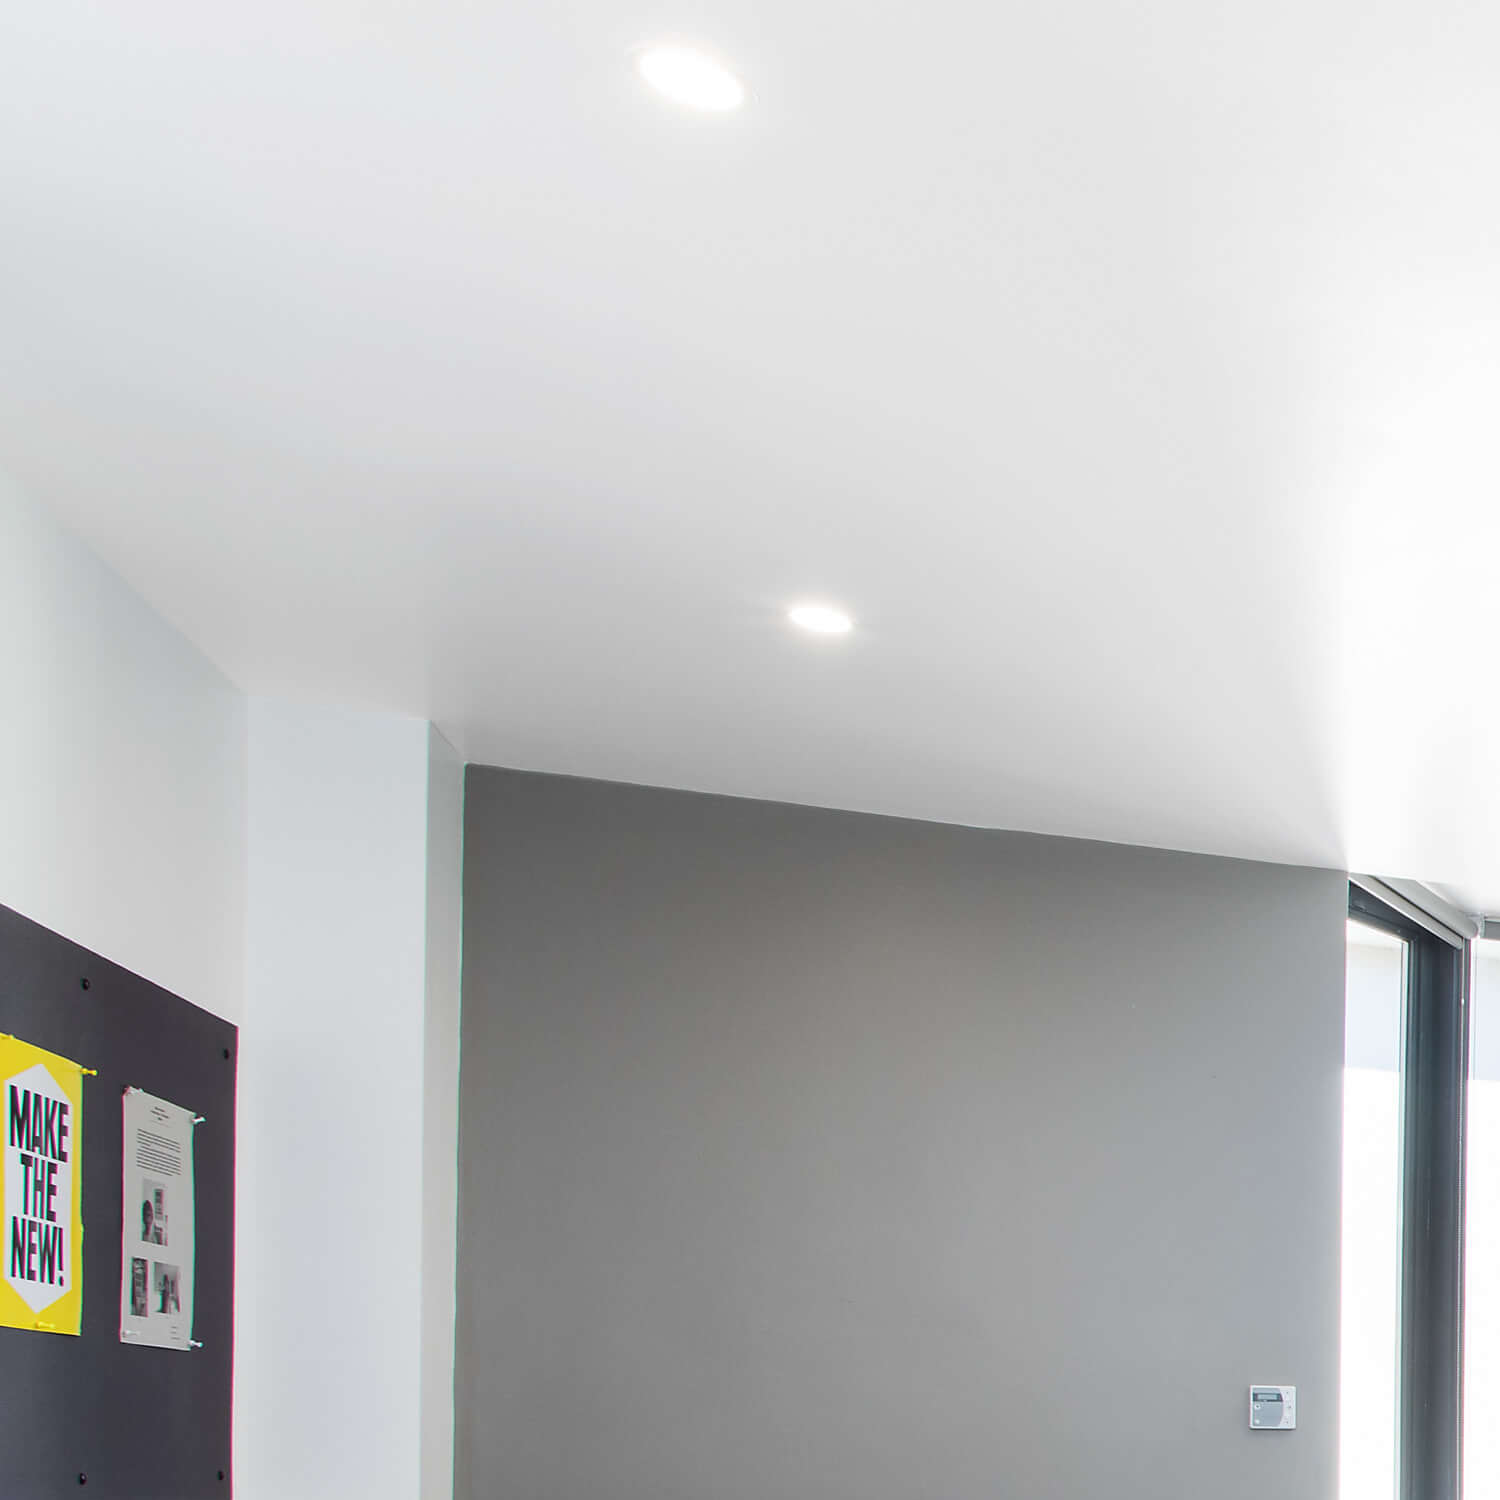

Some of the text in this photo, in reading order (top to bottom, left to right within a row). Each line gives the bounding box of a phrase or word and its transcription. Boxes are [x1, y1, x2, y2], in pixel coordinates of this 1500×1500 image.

[10, 1085, 68, 1162] MAKE
[20, 1153, 58, 1222] THE
[11, 1216, 64, 1287] NEW!
